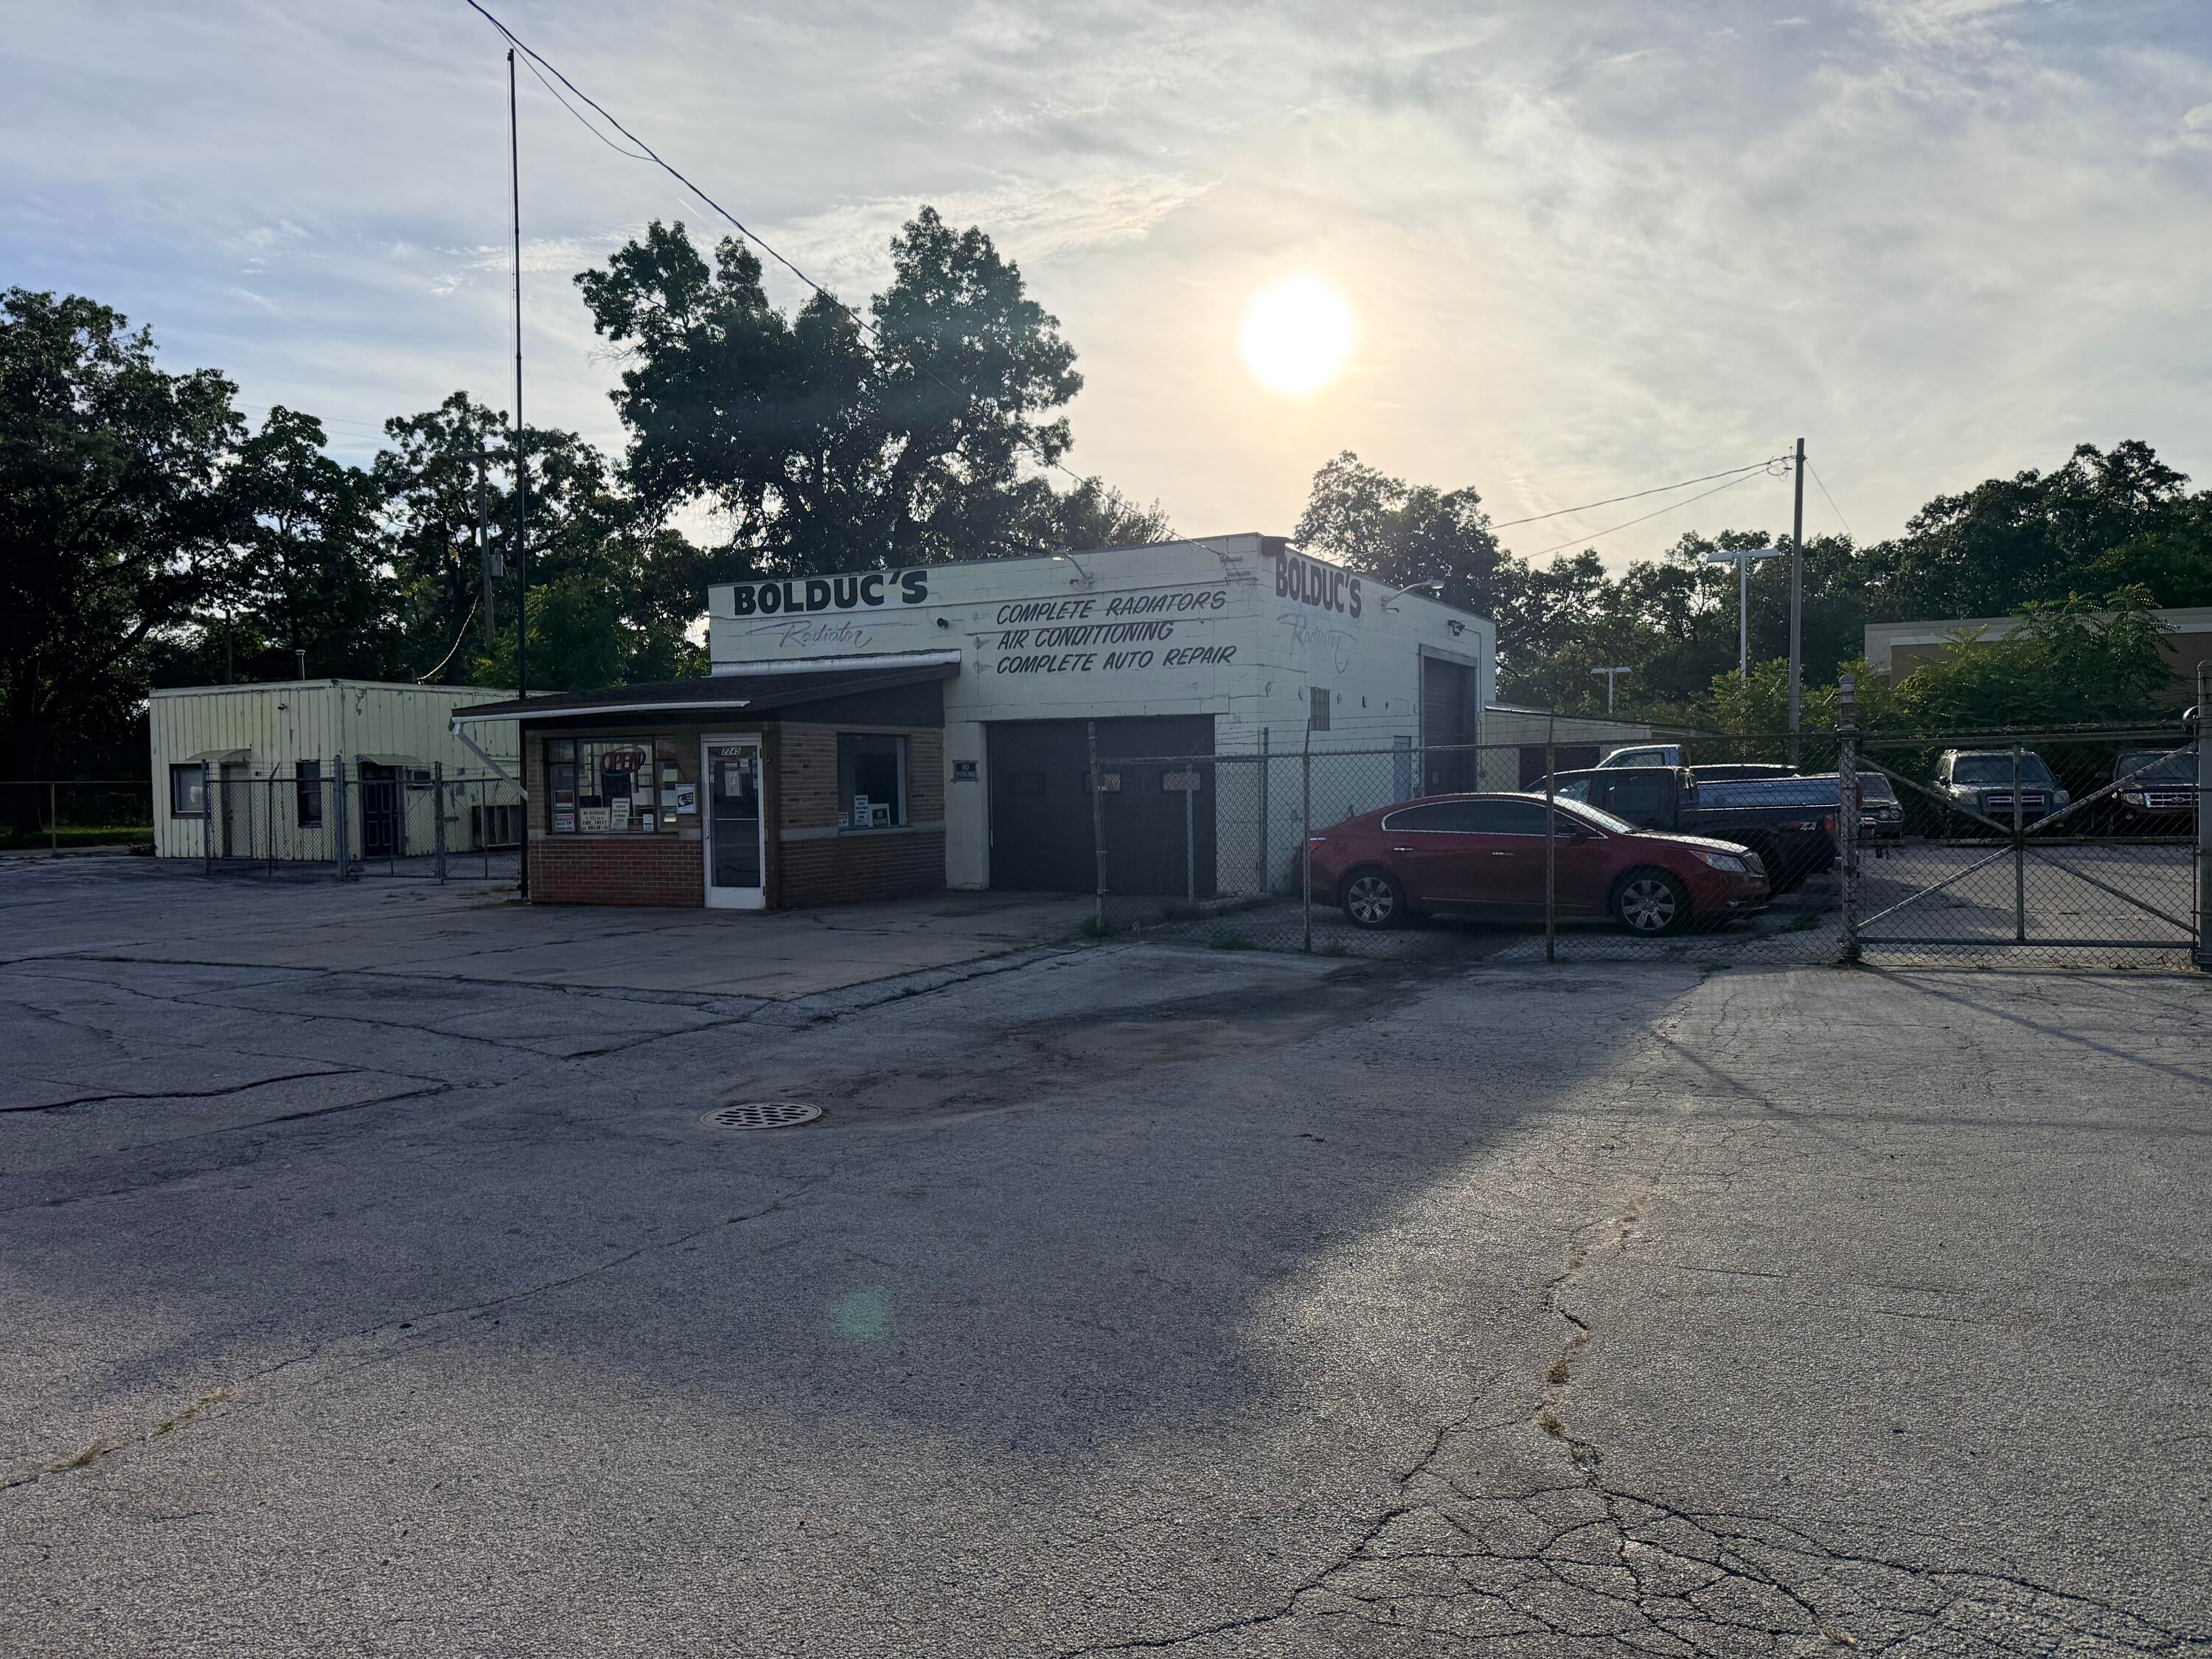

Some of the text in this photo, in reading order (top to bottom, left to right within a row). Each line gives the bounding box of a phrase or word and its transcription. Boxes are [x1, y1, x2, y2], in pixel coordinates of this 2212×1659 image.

[734, 570, 928, 616] BOLDUC'S
[1276, 554, 1362, 619] BOLDUC'S
[997, 591, 1228, 625] COMPLETE RADIATORS
[746, 620, 872, 649] Radiator
[997, 621, 1175, 650] AIR CONDITIONING
[997, 645, 1237, 674] COMPLETE AUTO REPAIR
[600, 751, 641, 771] OPEN
[721, 746, 741, 756] 2245
